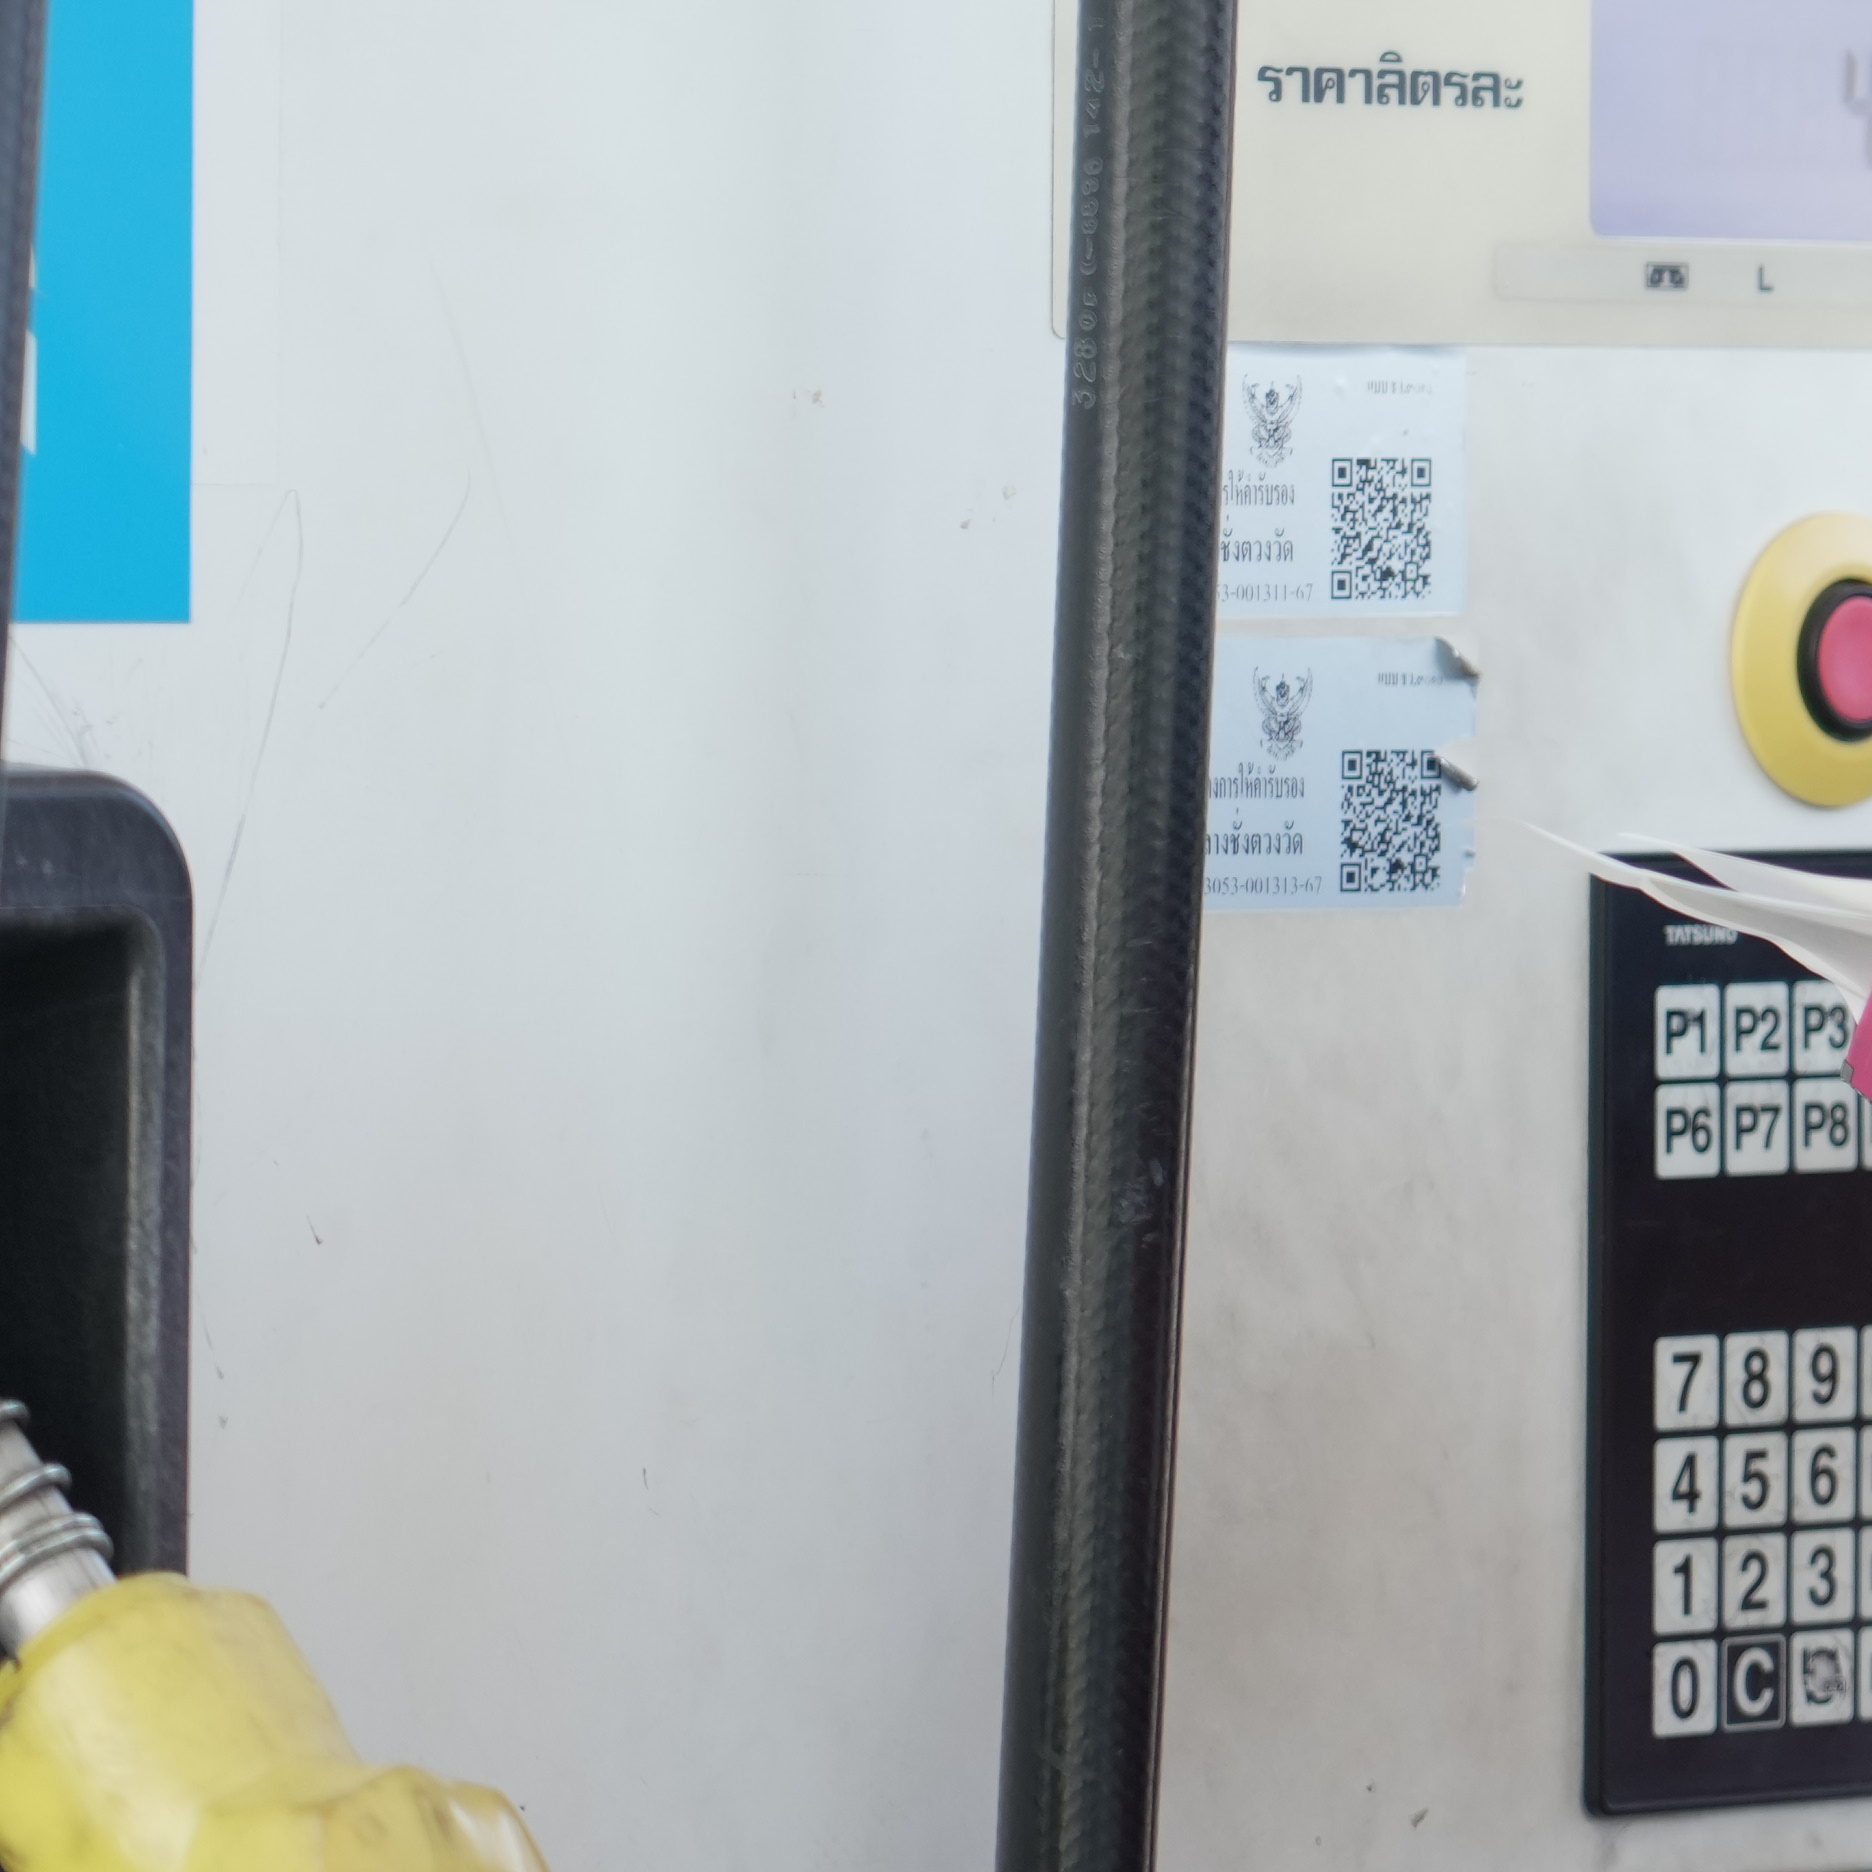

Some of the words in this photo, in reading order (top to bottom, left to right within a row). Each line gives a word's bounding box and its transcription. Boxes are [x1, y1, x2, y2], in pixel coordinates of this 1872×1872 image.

[1256, 50, 1524, 109] ราคาลิตรละ
[1758, 264, 1774, 292] L
[1664, 924, 1739, 946] TATSUNO
[1665, 1009, 1706, 1054] P1
[1734, 1005, 1781, 1053] P2
[1803, 1003, 1848, 1050] P3
[1666, 1107, 1712, 1154] P6
[1734, 1104, 1782, 1151] P7
[1804, 1101, 1849, 1148] P8
[1672, 1351, 1704, 1413] 7
[1742, 1347, 1772, 1409] 8
[1810, 1342, 1840, 1406] 9
[1671, 1451, 1701, 1515] 4
[1740, 1448, 1770, 1511] 5
[1810, 1443, 1838, 1507] 6
[1672, 1553, 1693, 1617] 1
[1739, 1549, 1769, 1613] 2
[1808, 1544, 1838, 1607] 3
[1670, 1656, 1699, 1720] 0
[1733, 1646, 1776, 1718] C
